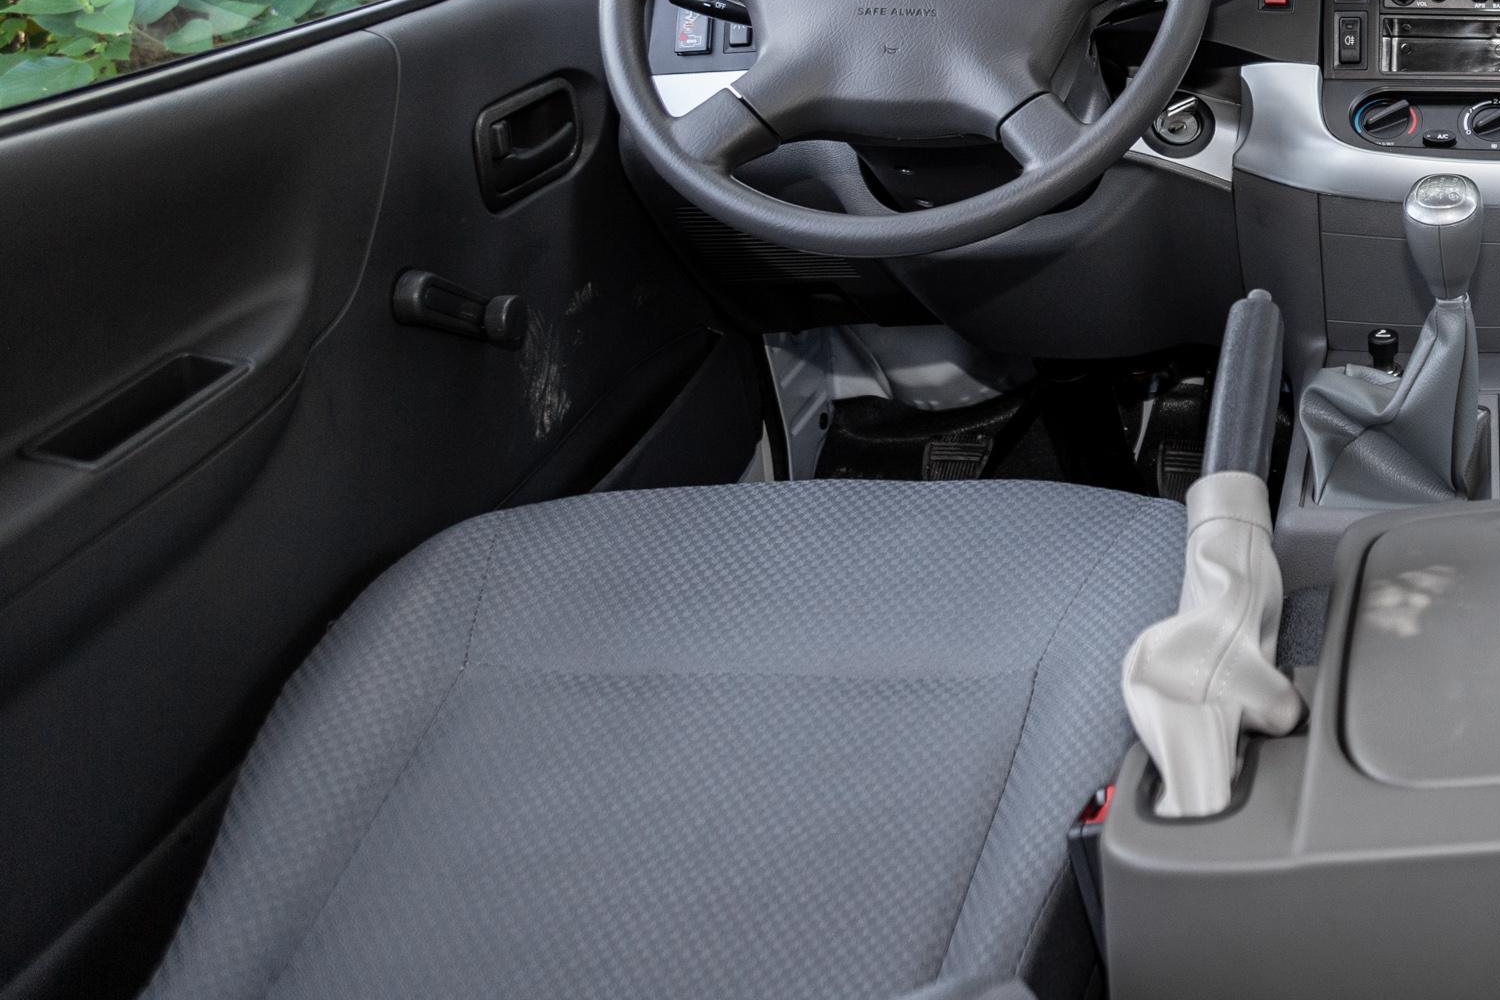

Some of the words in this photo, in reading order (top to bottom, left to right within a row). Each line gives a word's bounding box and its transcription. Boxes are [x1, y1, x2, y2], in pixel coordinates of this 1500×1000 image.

[715, 1, 726, 9] OFF
[857, 7, 888, 16] SAFE
[890, 7, 937, 17] ALWAYS
